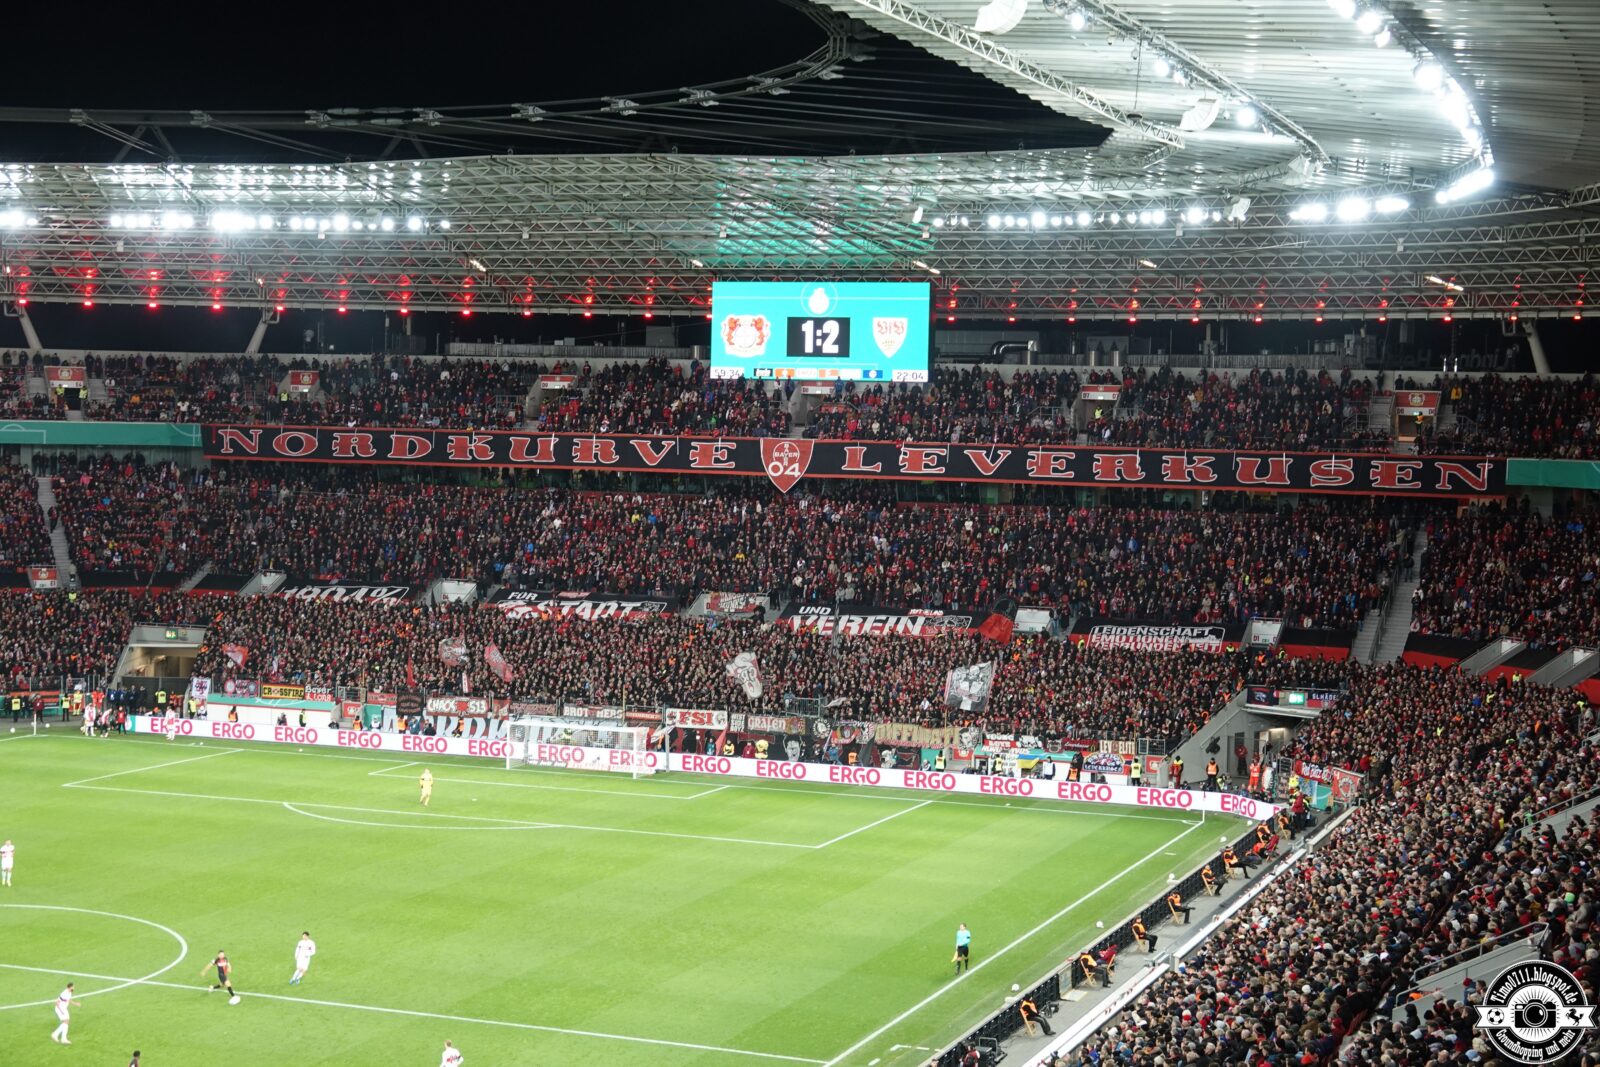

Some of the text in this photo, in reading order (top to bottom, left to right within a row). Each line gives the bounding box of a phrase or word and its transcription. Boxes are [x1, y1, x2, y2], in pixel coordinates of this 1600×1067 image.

[801, 319, 840, 354] 1:2
[896, 371, 924, 381] 22:04
[218, 429, 1494, 491] NORDKURVE LEVERKUSEN
[768, 461, 802, 478] 04
[798, 605, 832, 616] UND
[789, 614, 926, 636] VEREIN
[1093, 626, 1211, 638] LEIDENSCHAFT
[1091, 634, 1188, 645] EMOTIONEN
[679, 711, 713, 726] FSI
[212, 721, 255, 740] ERGO
[275, 726, 318, 744] ERGO
[338, 730, 382, 748] ERGO
[402, 735, 447, 753] ERGO
[468, 738, 515, 757] ERGO
[538, 744, 584, 763] ERGO
[682, 755, 732, 774] ERGO
[756, 760, 806, 779] ERGO
[830, 766, 881, 785] ERGO
[904, 771, 956, 791] ERGO
[980, 776, 1033, 796] ERGO
[1058, 782, 1112, 802] ERGO
[1137, 788, 1192, 808] ERGO
[1221, 794, 1257, 818] ERGO
